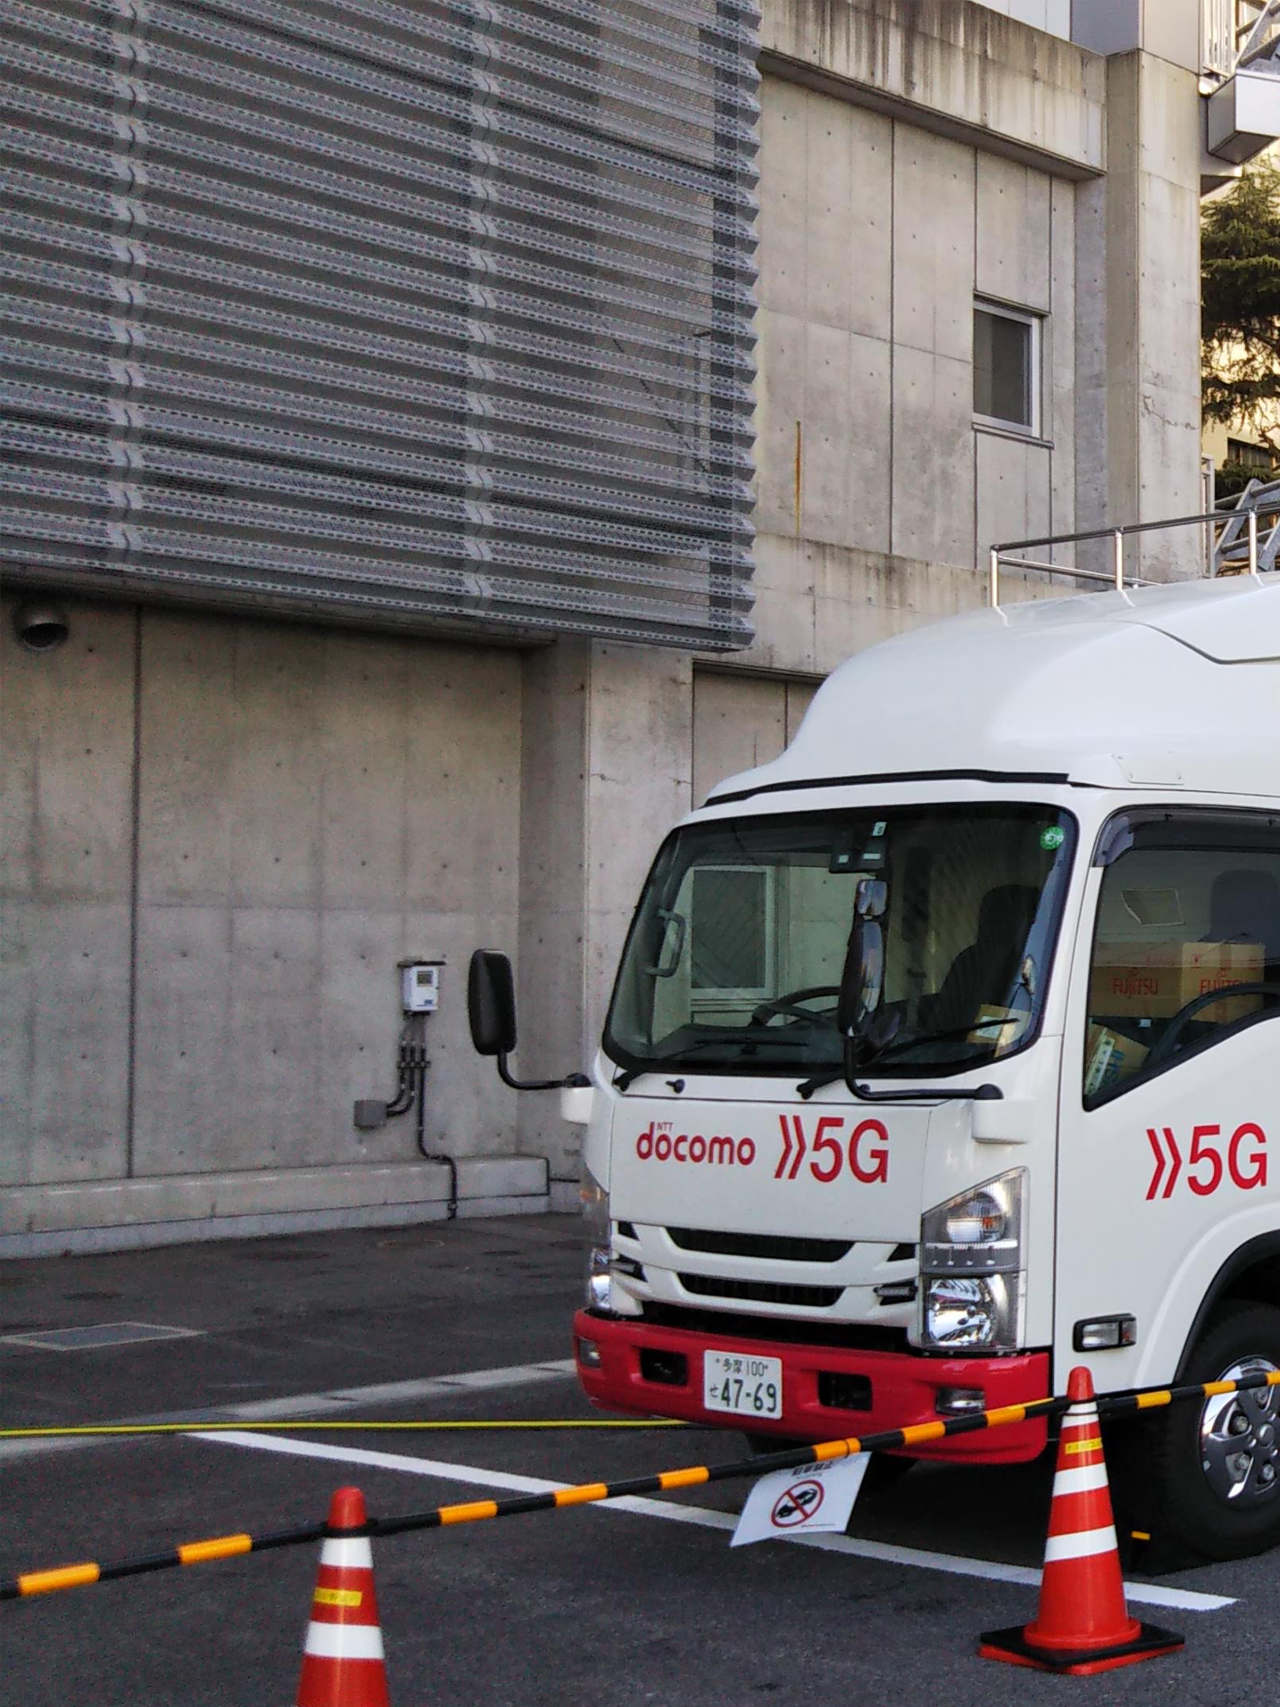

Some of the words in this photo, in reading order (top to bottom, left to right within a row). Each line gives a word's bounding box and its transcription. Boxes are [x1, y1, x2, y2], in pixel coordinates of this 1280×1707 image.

[1113, 977, 1159, 997] FUJITSU
[657, 1122, 674, 1132] NTT
[636, 1121, 756, 1166] docomo
[809, 1116, 889, 1184] 5G
[1187, 1122, 1268, 1196] 5G
[722, 1357, 743, 1374] 多摩
[747, 1360, 765, 1377] 100
[721, 1377, 777, 1413] 47-69
